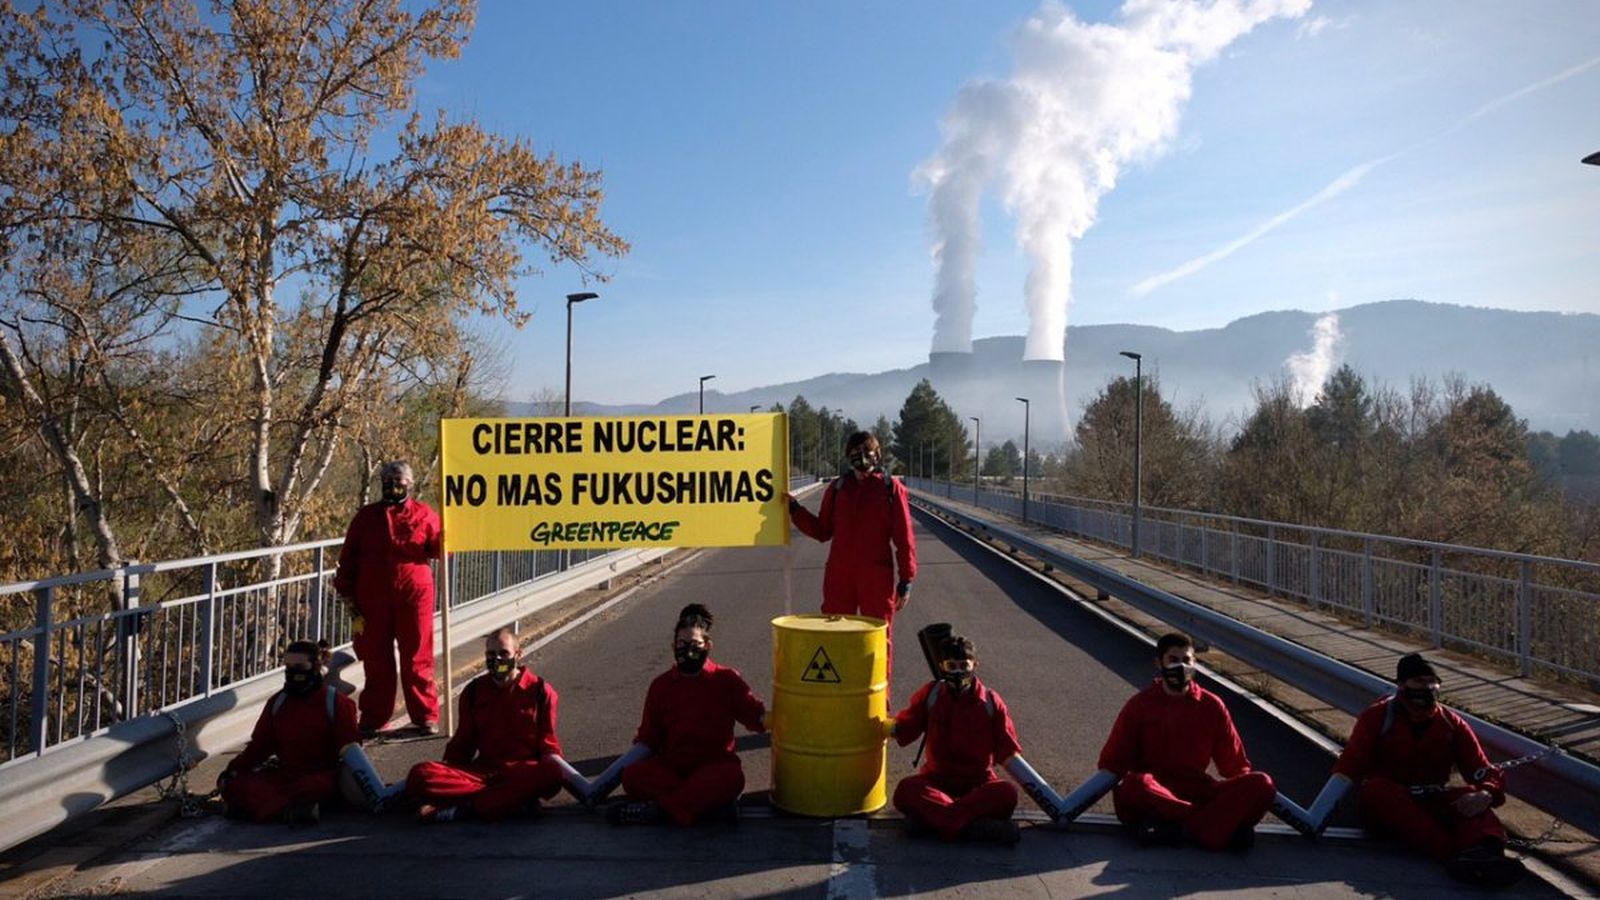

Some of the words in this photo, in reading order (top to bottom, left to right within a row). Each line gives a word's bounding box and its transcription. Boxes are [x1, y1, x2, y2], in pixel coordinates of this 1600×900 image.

[472, 421, 582, 454] CIERRE
[593, 420, 744, 453] NUCLEAR:
[445, 474, 486, 507] NO
[497, 473, 561, 506] MAS
[571, 469, 773, 505] FUKUSHIMAS
[530, 521, 680, 546] GREENPEACE
